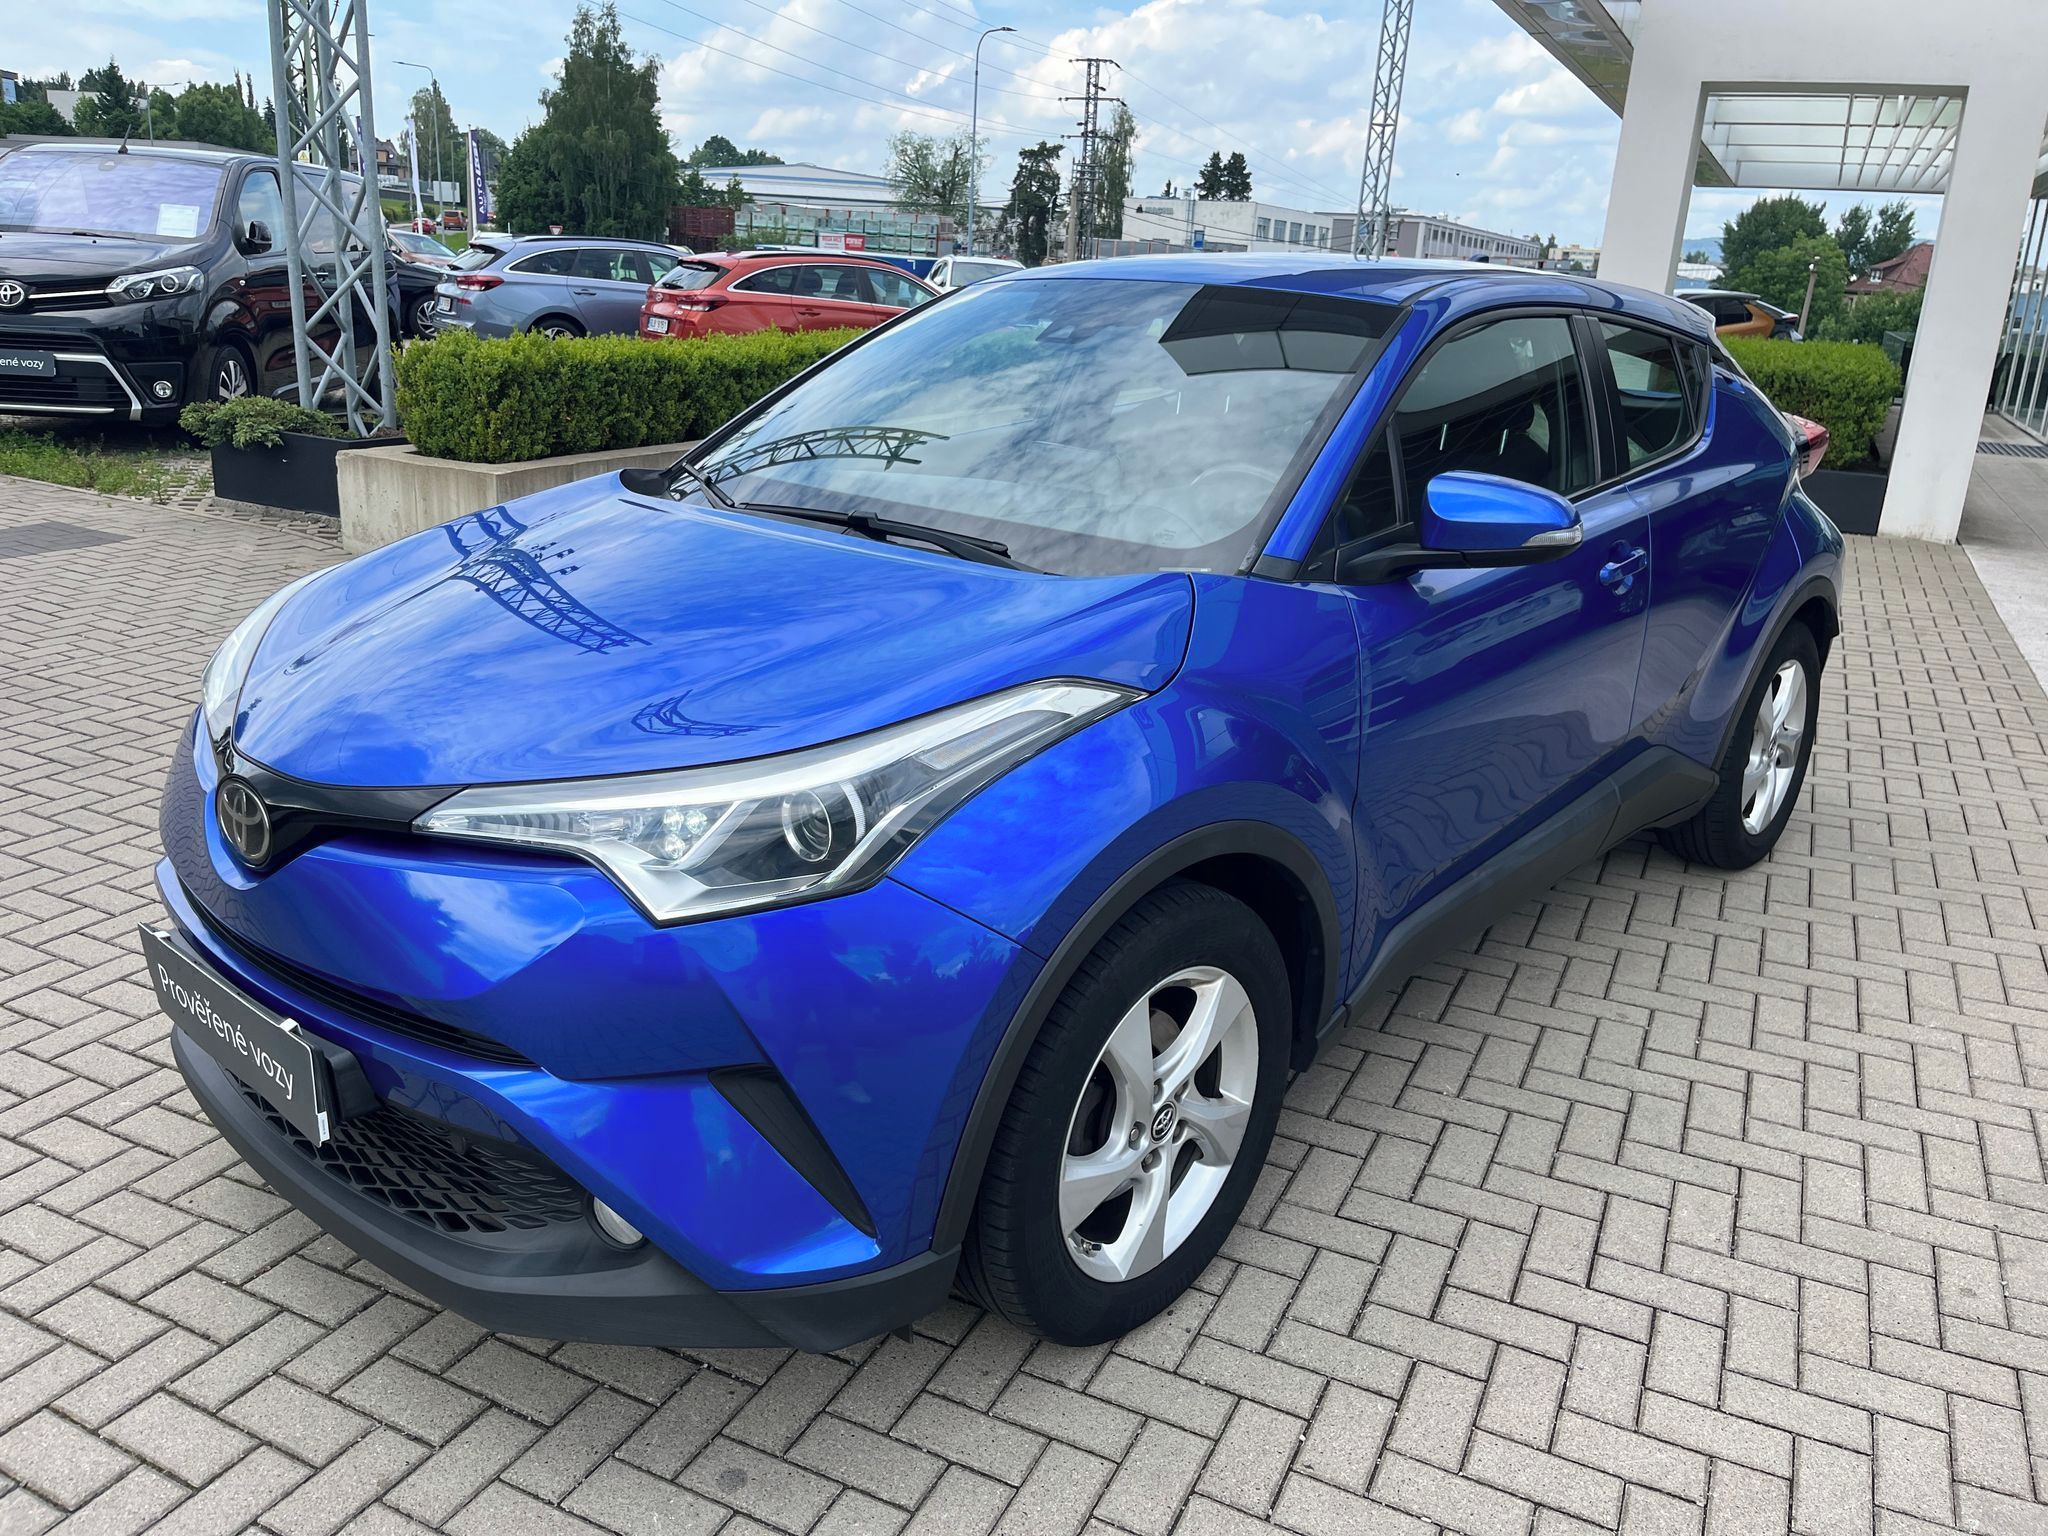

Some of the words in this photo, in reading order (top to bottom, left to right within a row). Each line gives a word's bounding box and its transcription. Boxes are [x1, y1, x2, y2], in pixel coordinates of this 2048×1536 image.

[20, 359, 44, 370] vozy
[157, 963, 248, 1056] Prověřené
[249, 1041, 294, 1101] vozy
